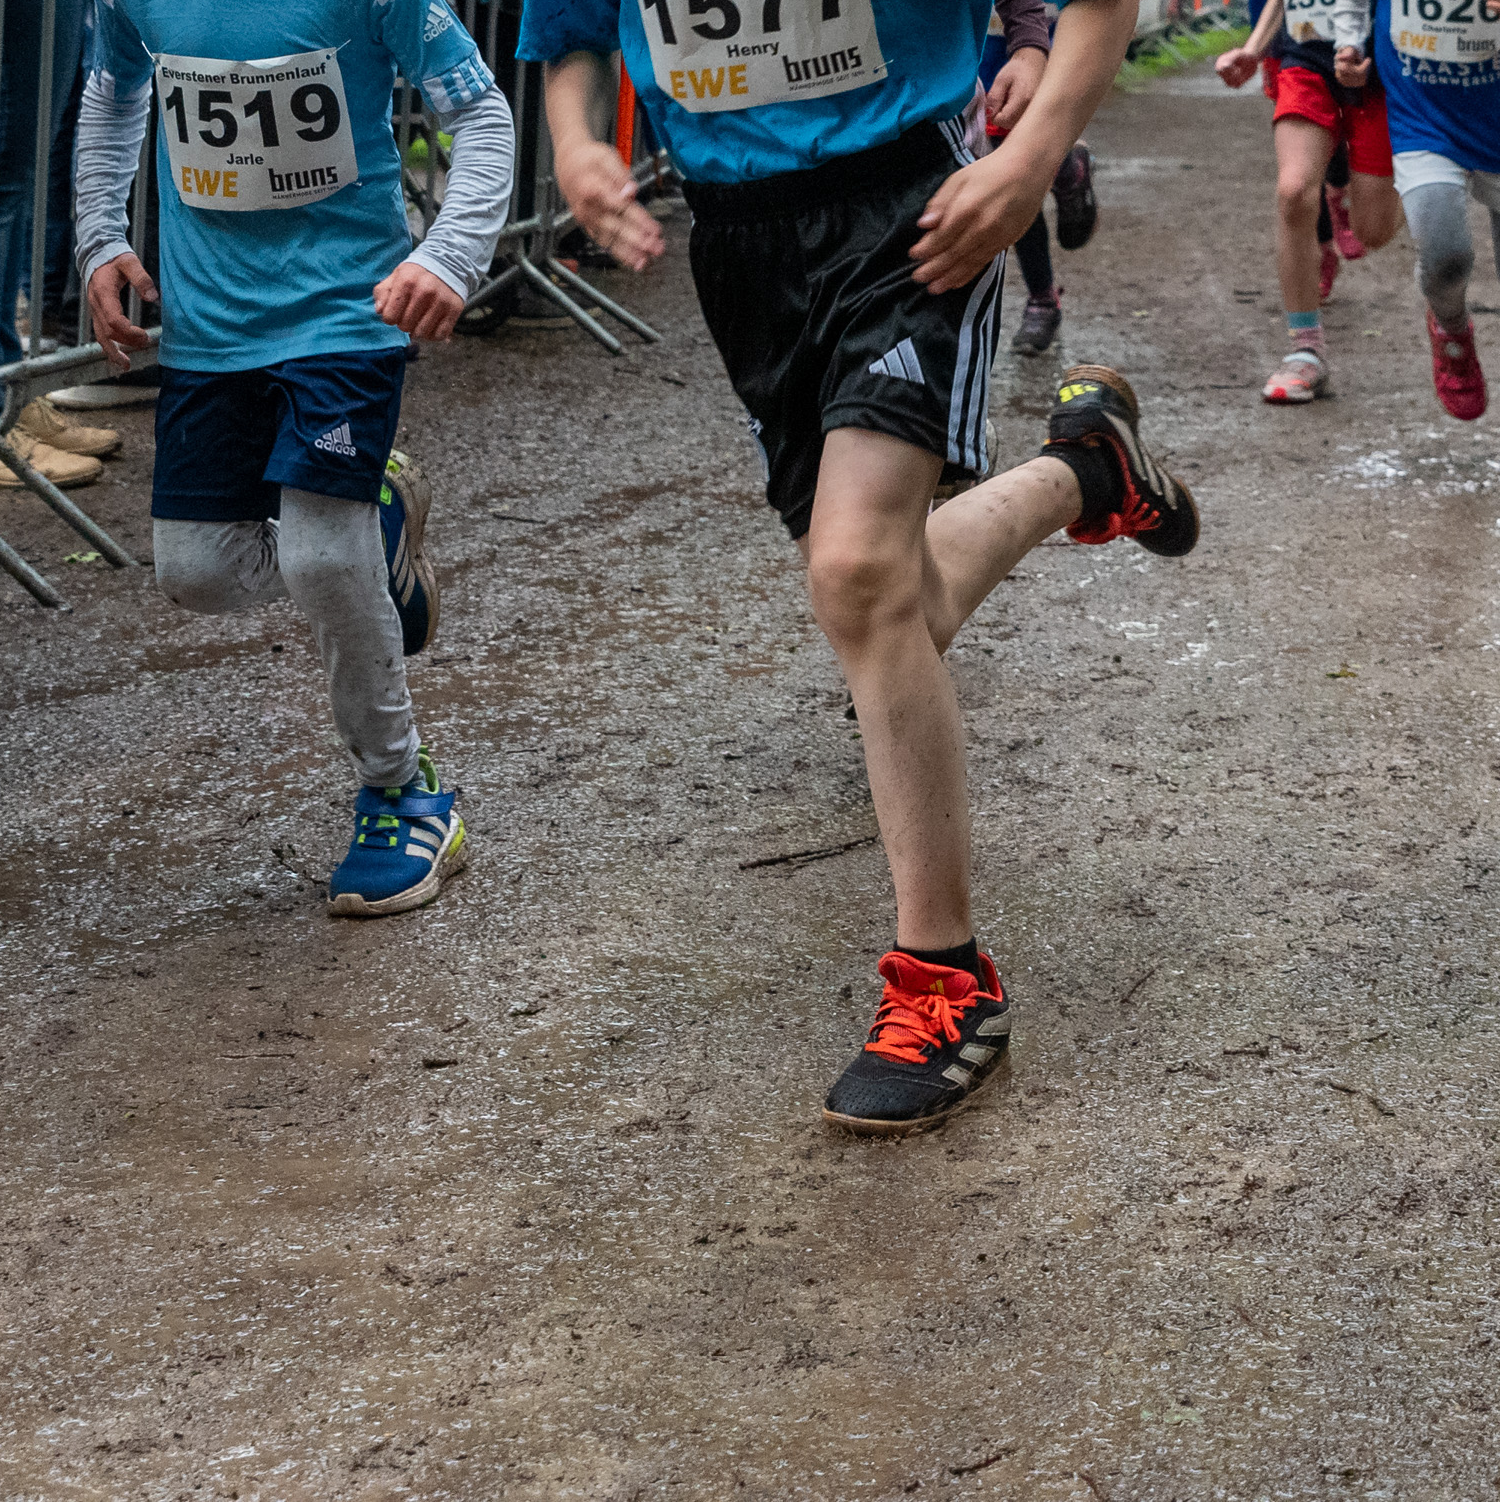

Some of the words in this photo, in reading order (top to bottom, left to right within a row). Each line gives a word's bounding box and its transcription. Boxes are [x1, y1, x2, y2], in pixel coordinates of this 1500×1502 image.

[726, 42, 779, 59] Henry
[1400, 30, 1438, 52] EWE
[1457, 36, 1496, 52] bruns
[162, 66, 226, 85] Everstener
[230, 62, 327, 85] Brunnenlauf
[669, 64, 749, 100] EWE
[782, 46, 862, 83] bruns
[165, 83, 341, 148] 1519
[226, 153, 264, 166] Jarle
[181, 166, 239, 198] EWE
[268, 166, 339, 192] bruns
[314, 438, 356, 457] adidas
